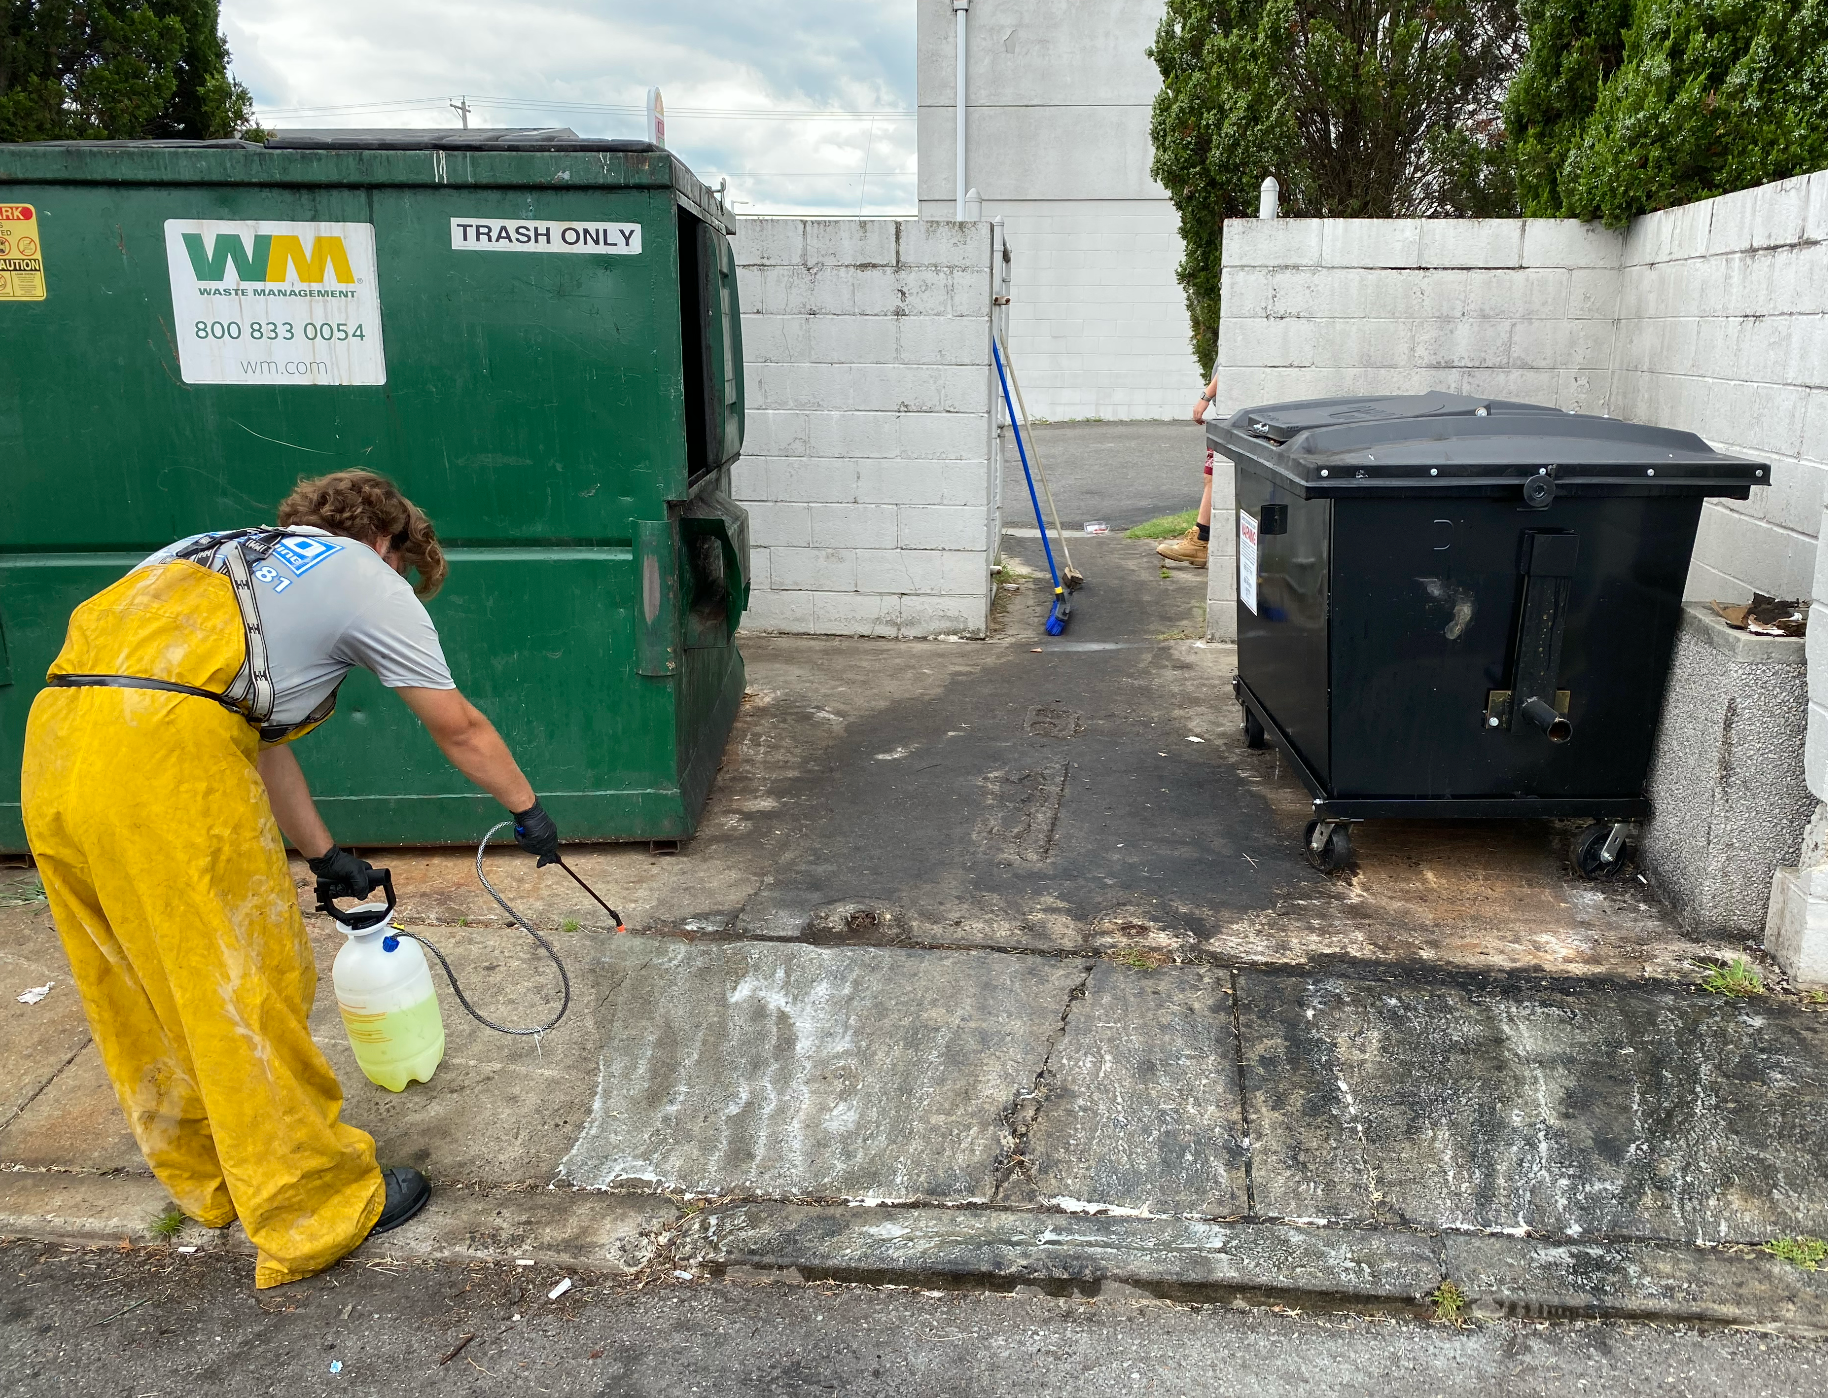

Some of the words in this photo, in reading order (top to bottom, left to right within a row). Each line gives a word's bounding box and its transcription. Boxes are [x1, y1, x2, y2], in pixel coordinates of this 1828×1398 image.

[0, 207, 24, 219] RK
[457, 224, 551, 244] TRASH
[561, 228, 635, 247] ONLY
[181, 233, 355, 284] WM
[198, 288, 248, 297] WASTE
[253, 289, 356, 298] MANAGEMENT
[195, 321, 241, 340] 800
[250, 322, 294, 341] 833
[303, 323, 365, 341] 0054
[241, 360, 328, 375] wm.com
